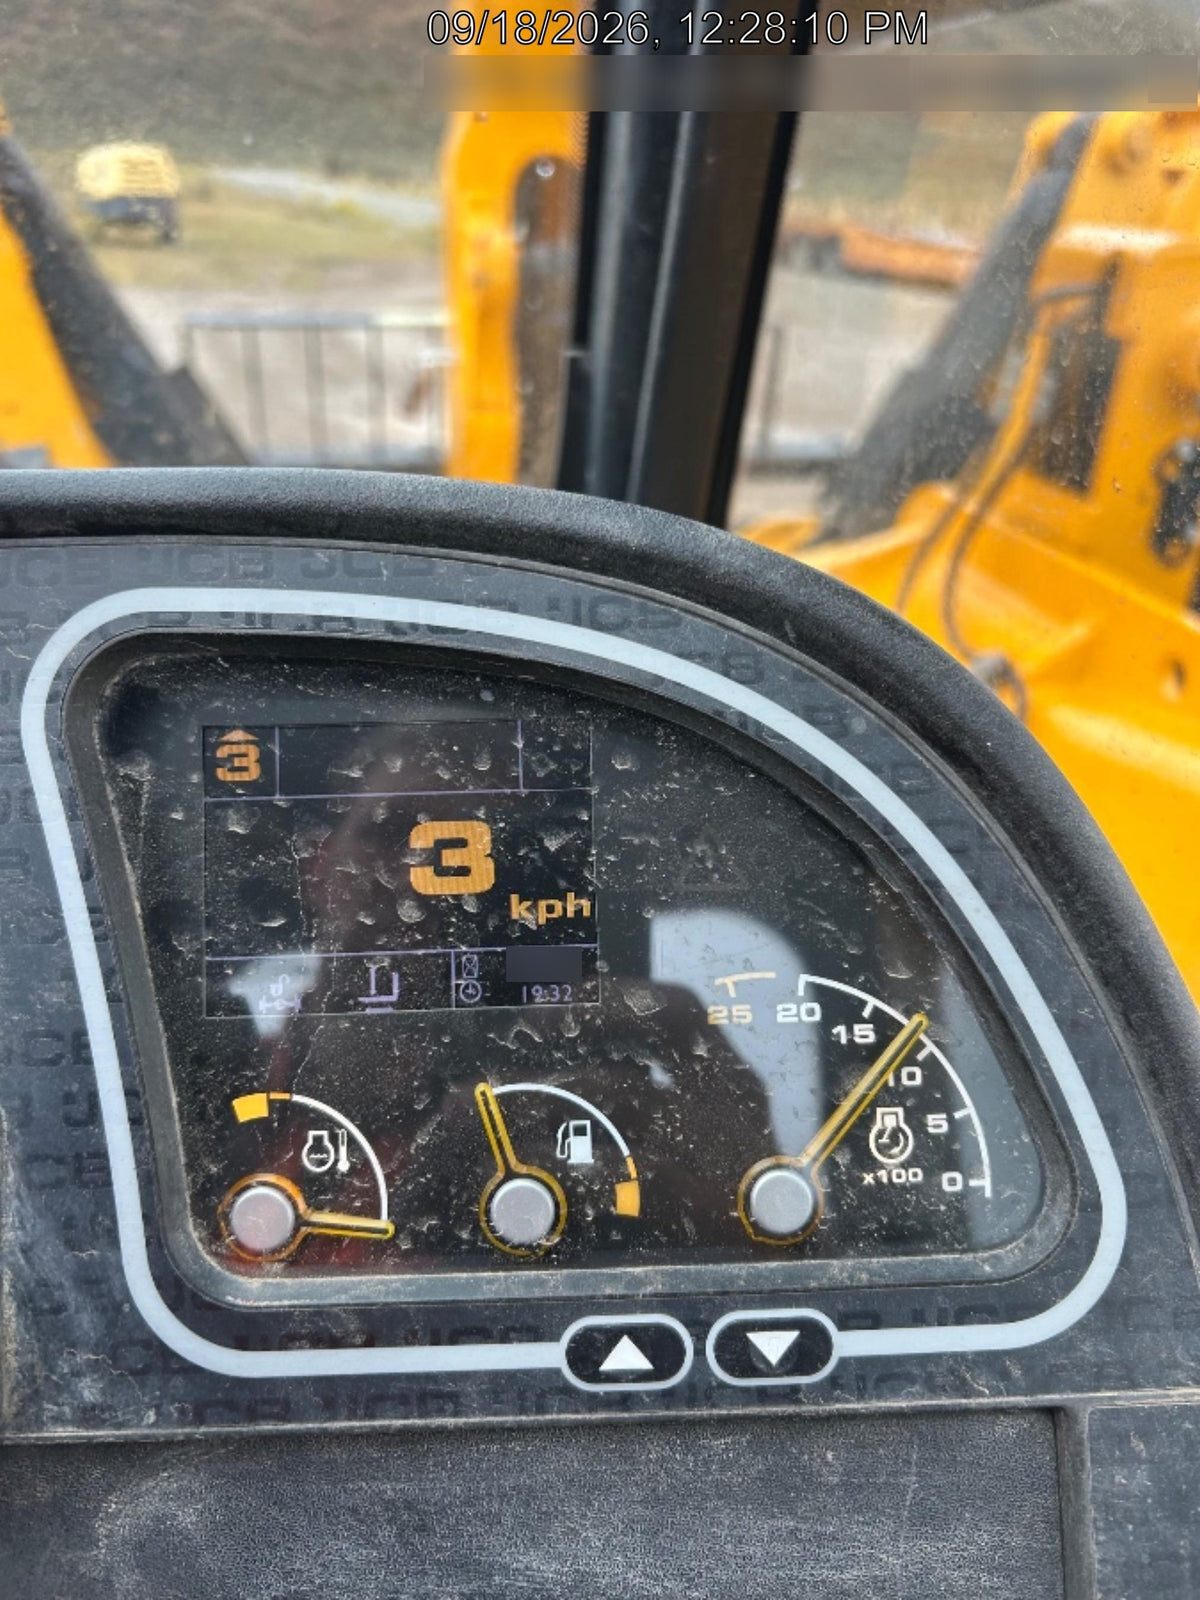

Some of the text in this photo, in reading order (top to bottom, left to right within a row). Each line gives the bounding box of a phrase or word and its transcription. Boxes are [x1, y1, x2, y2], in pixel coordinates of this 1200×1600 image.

[215, 743, 261, 782] 3
[409, 820, 495, 896] 3
[510, 892, 592, 926] kph
[706, 1004, 753, 1025] 25
[776, 1001, 822, 1024] 20
[831, 1023, 877, 1045] 15
[926, 1112, 949, 1134] 5
[862, 1167, 924, 1185] x100
[941, 1170, 963, 1192] 0
